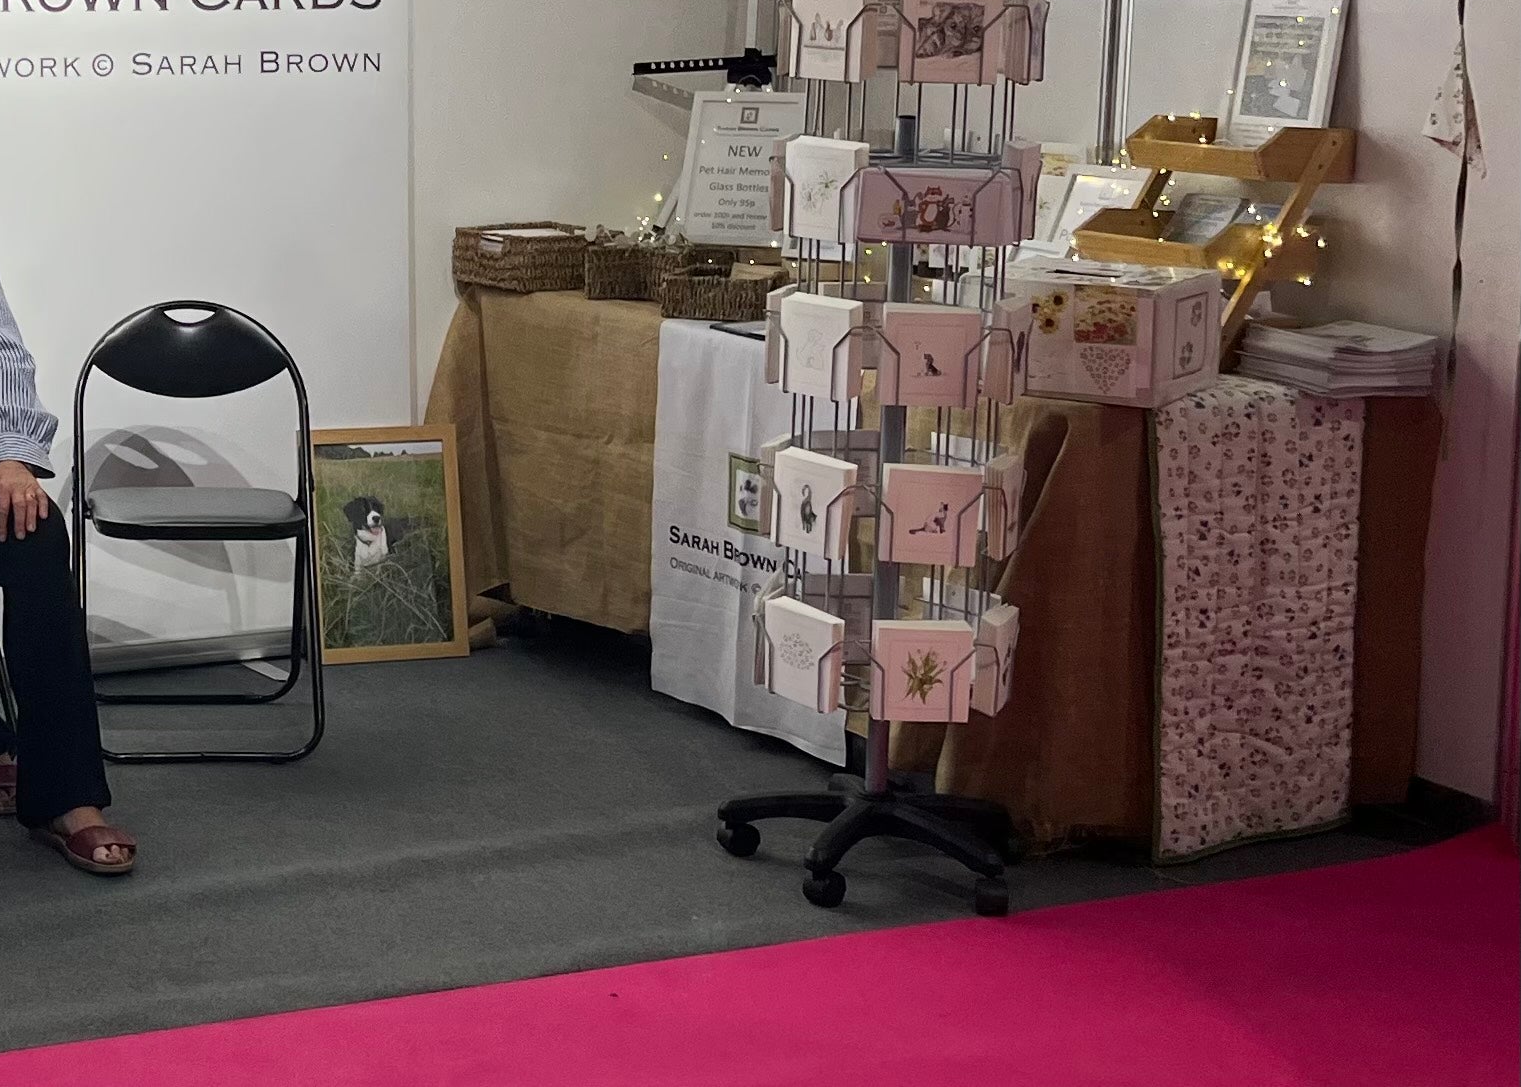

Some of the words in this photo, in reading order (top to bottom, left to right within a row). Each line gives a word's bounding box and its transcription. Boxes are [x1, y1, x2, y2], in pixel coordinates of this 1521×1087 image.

[132, 52, 242, 75] SARAH
[260, 51, 381, 73] BROWN
[727, 145, 763, 157] NEW
[699, 165, 714, 174] Pet
[717, 166, 736, 175] Hair
[739, 167, 770, 176] Memo
[709, 181, 733, 191] Glass
[736, 182, 769, 193] Bottles
[718, 198, 737, 207] Only
[669, 525, 720, 556] SARAH
[669, 557, 712, 579] ORIGINAL
